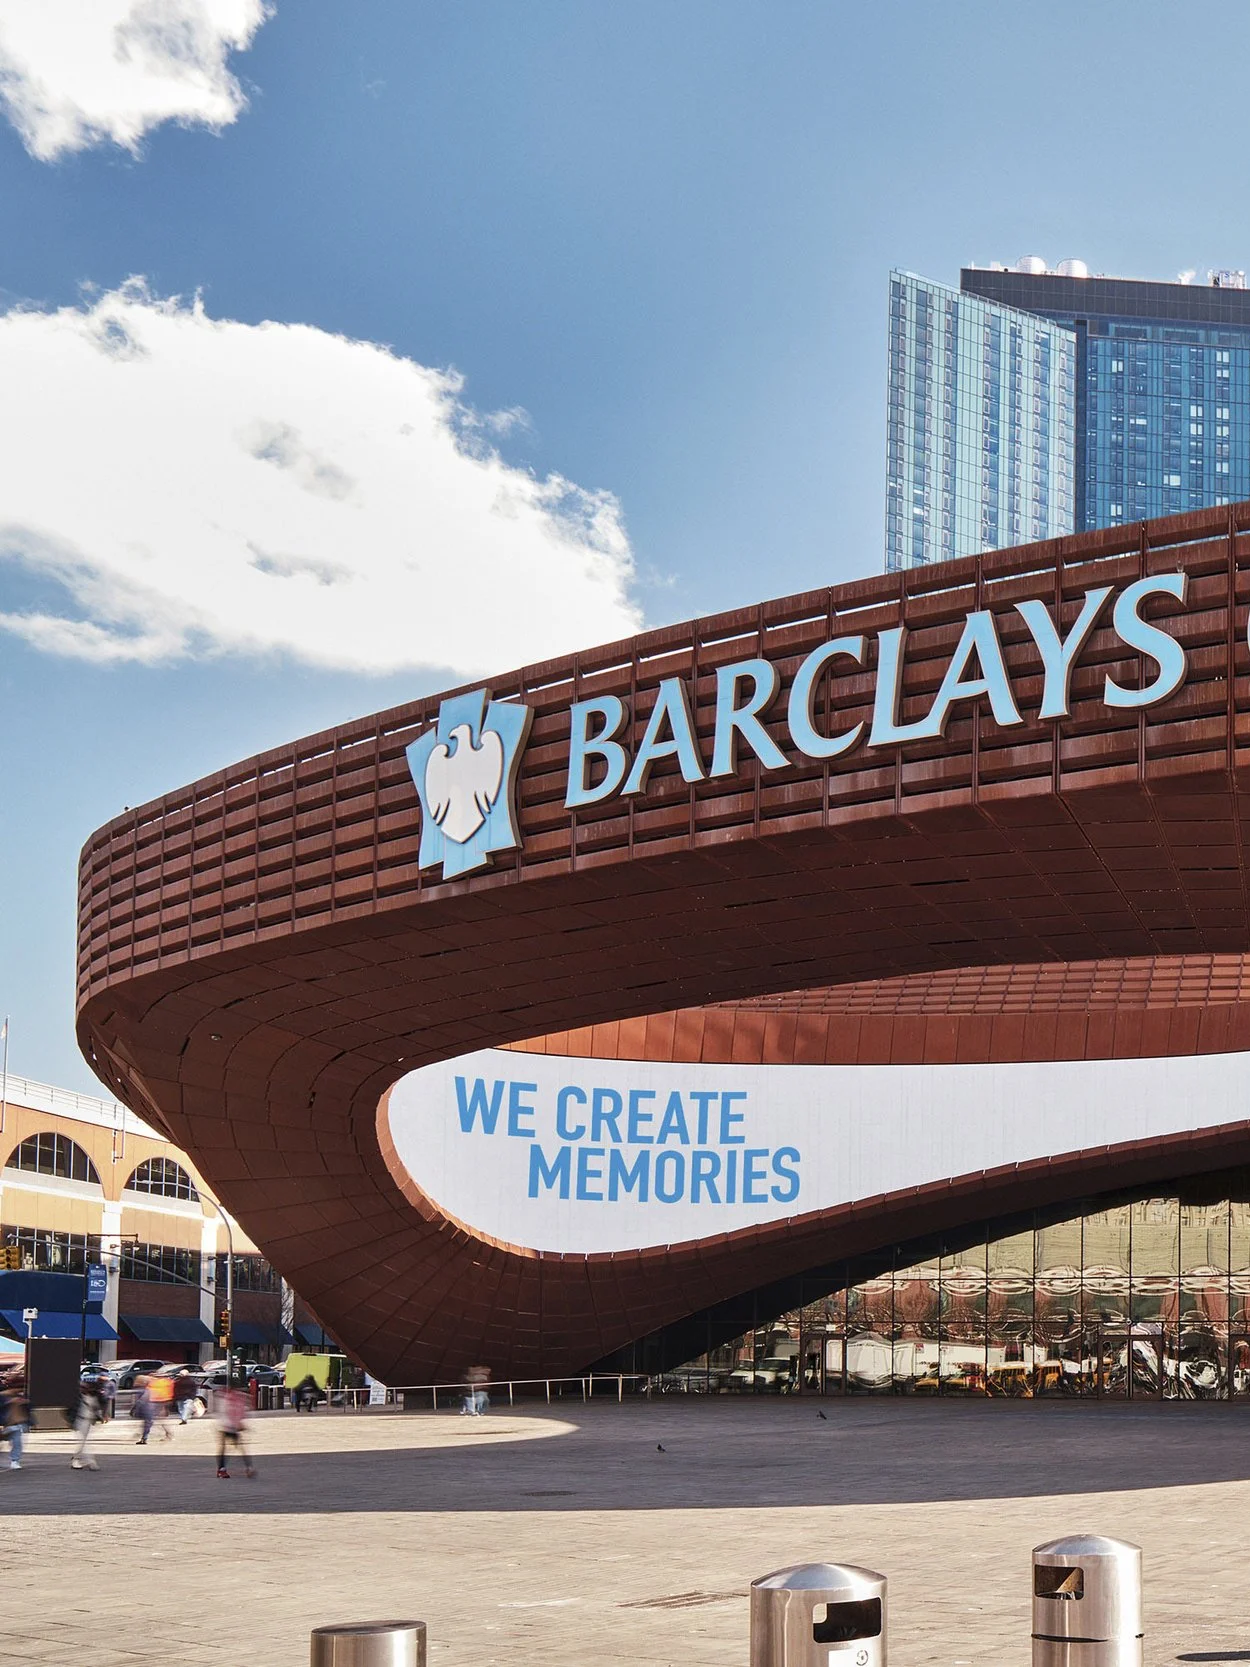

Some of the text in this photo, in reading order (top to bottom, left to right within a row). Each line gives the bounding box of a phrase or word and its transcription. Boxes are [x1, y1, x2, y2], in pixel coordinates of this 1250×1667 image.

[564, 571, 1188, 810] BARCLAYS
[454, 1076, 748, 1145] WE CREATE
[528, 1143, 801, 1204] MEMORIES
